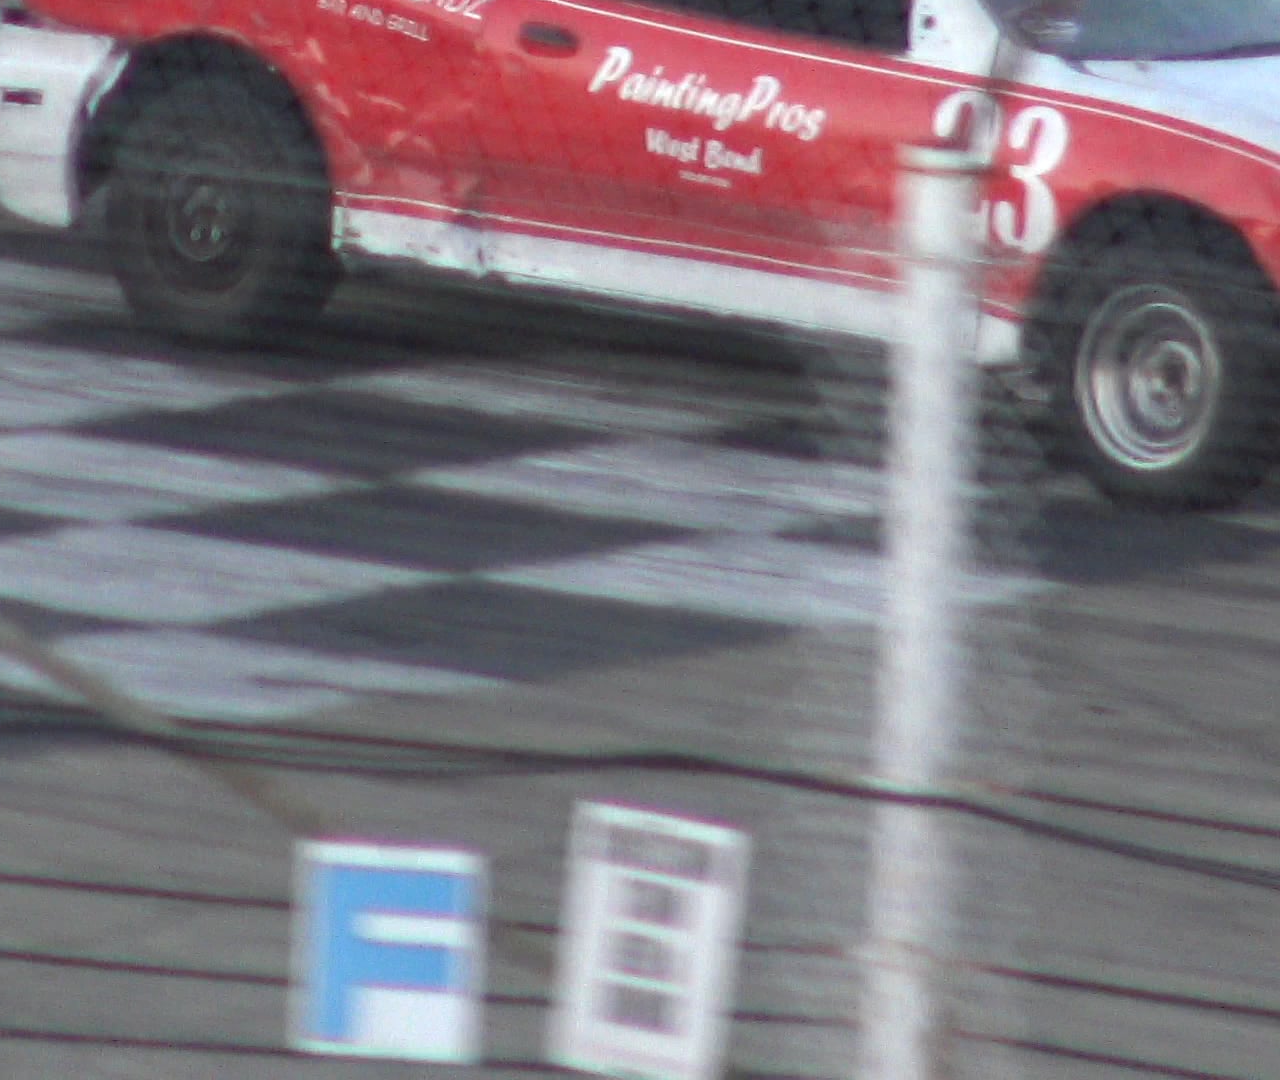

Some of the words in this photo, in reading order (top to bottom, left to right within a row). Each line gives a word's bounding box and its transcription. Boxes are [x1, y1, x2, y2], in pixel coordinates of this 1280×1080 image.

[348, 3, 386, 27] AND
[645, 126, 701, 163] West
[704, 139, 763, 174] Bend
